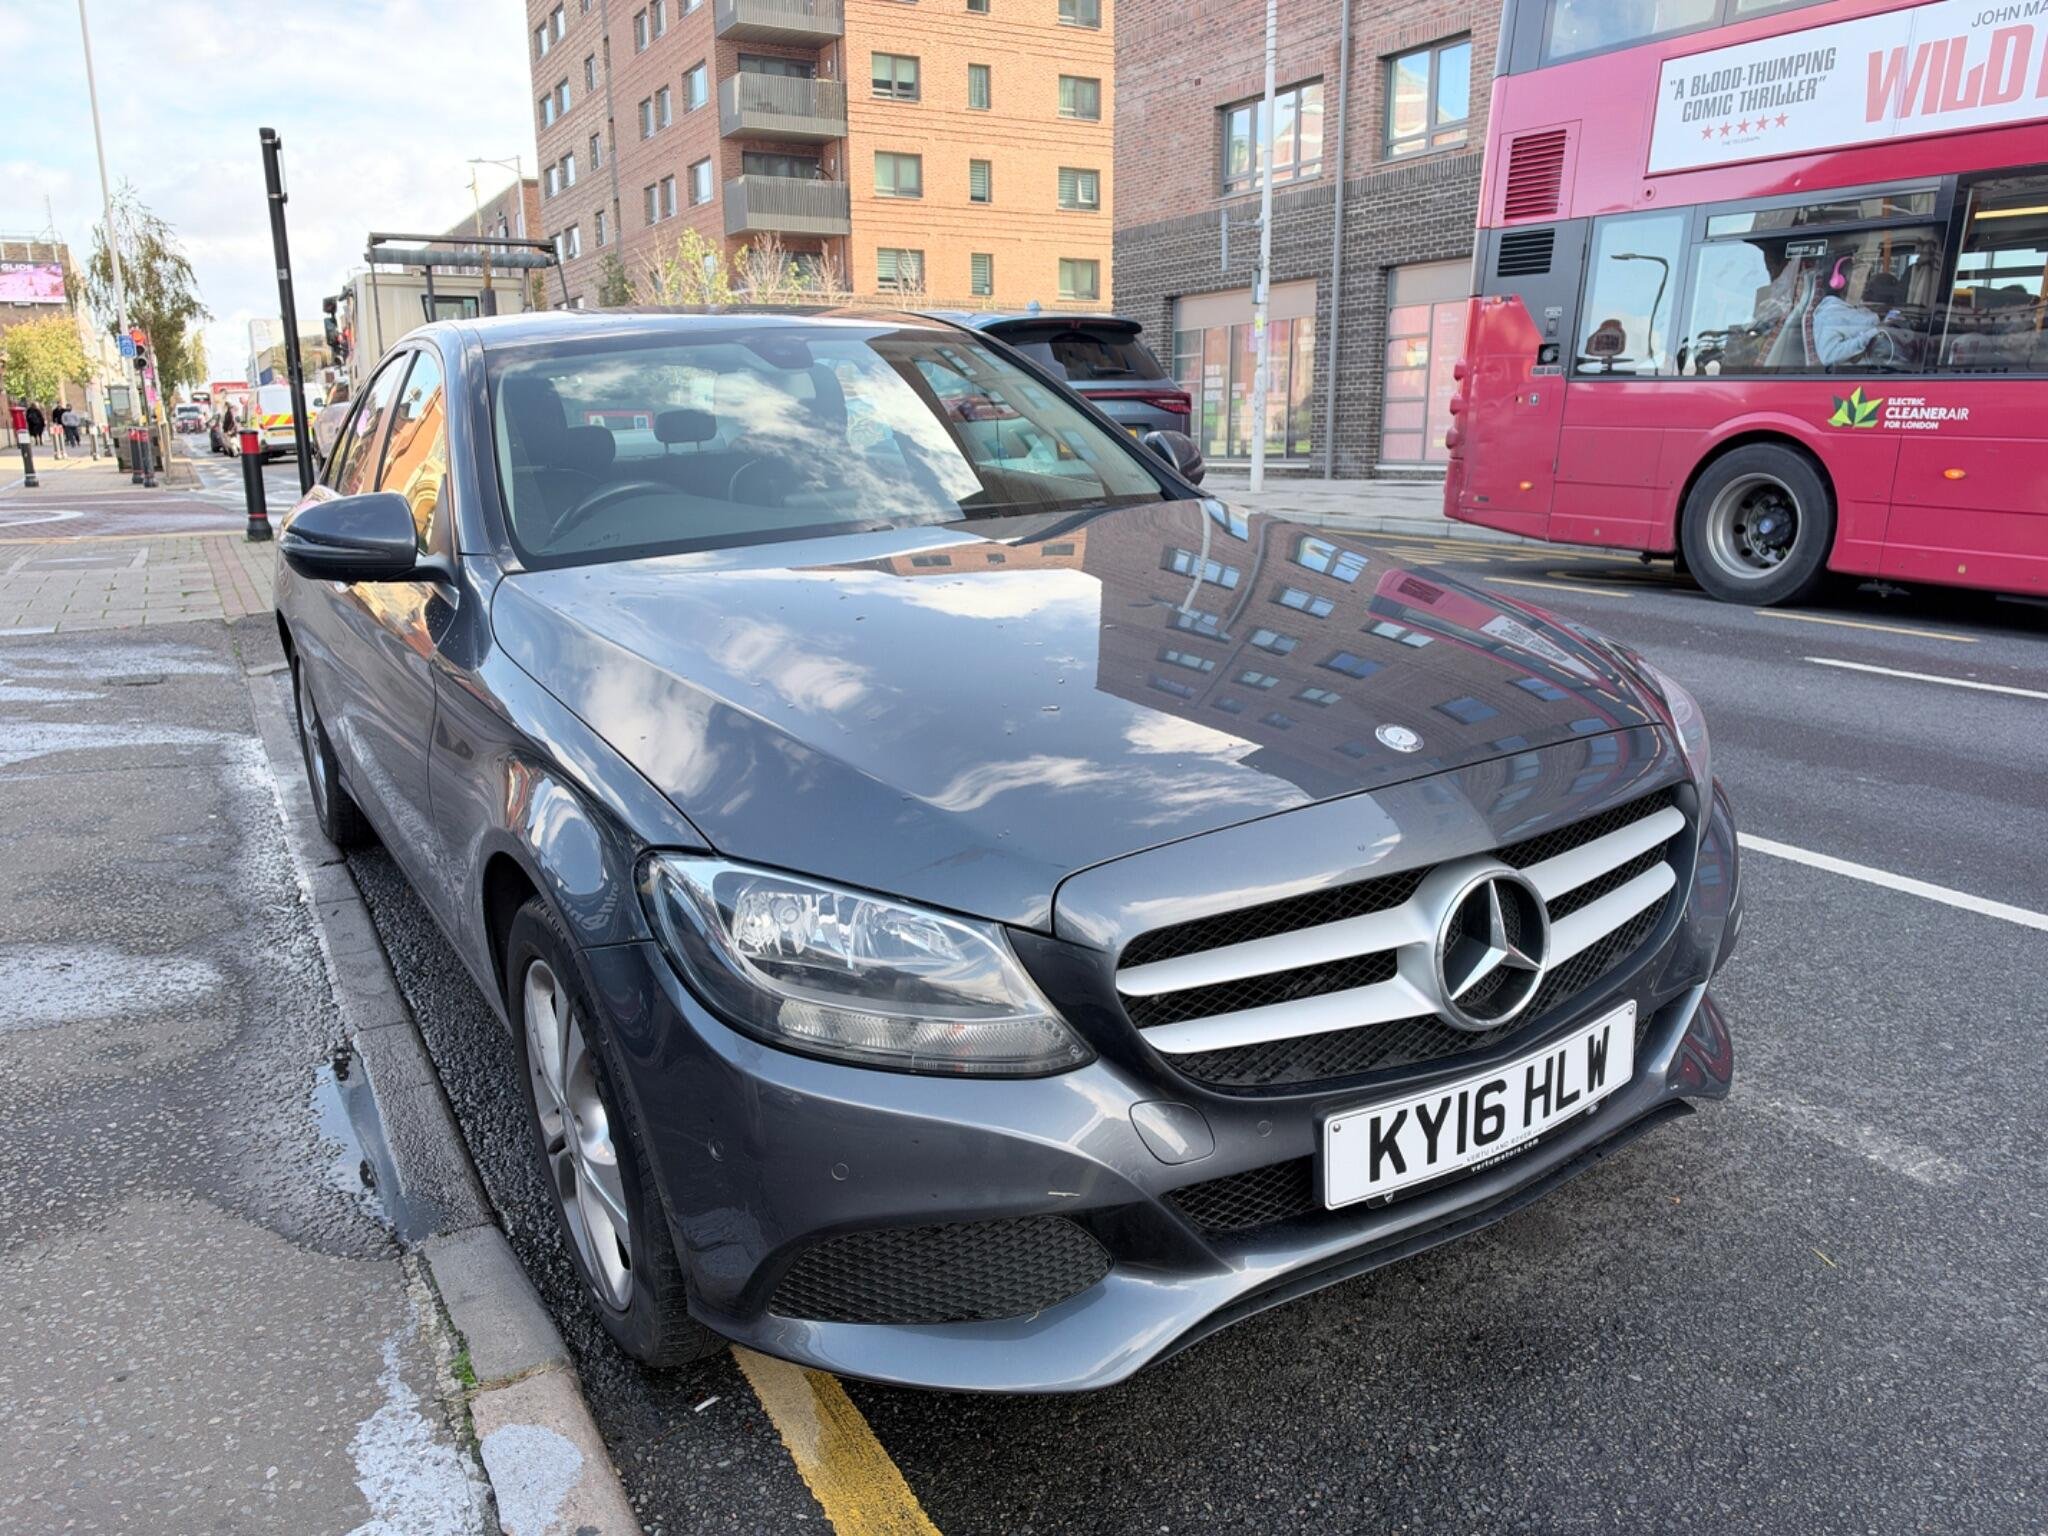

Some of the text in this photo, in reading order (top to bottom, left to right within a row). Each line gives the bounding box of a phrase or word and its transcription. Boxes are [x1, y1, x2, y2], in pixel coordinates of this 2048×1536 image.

[1971, 4, 2022, 28] JOHN
[1690, 46, 1837, 97] BLOOD-THUMPING
[1865, 24, 2035, 123] WILD
[1681, 74, 1828, 123] COMIC THRILLER"
[1884, 421, 1939, 430] FOR LONDON
[1888, 397, 1926, 406] ELECTRIC
[1368, 1025, 1611, 1184] KY16 HLW
